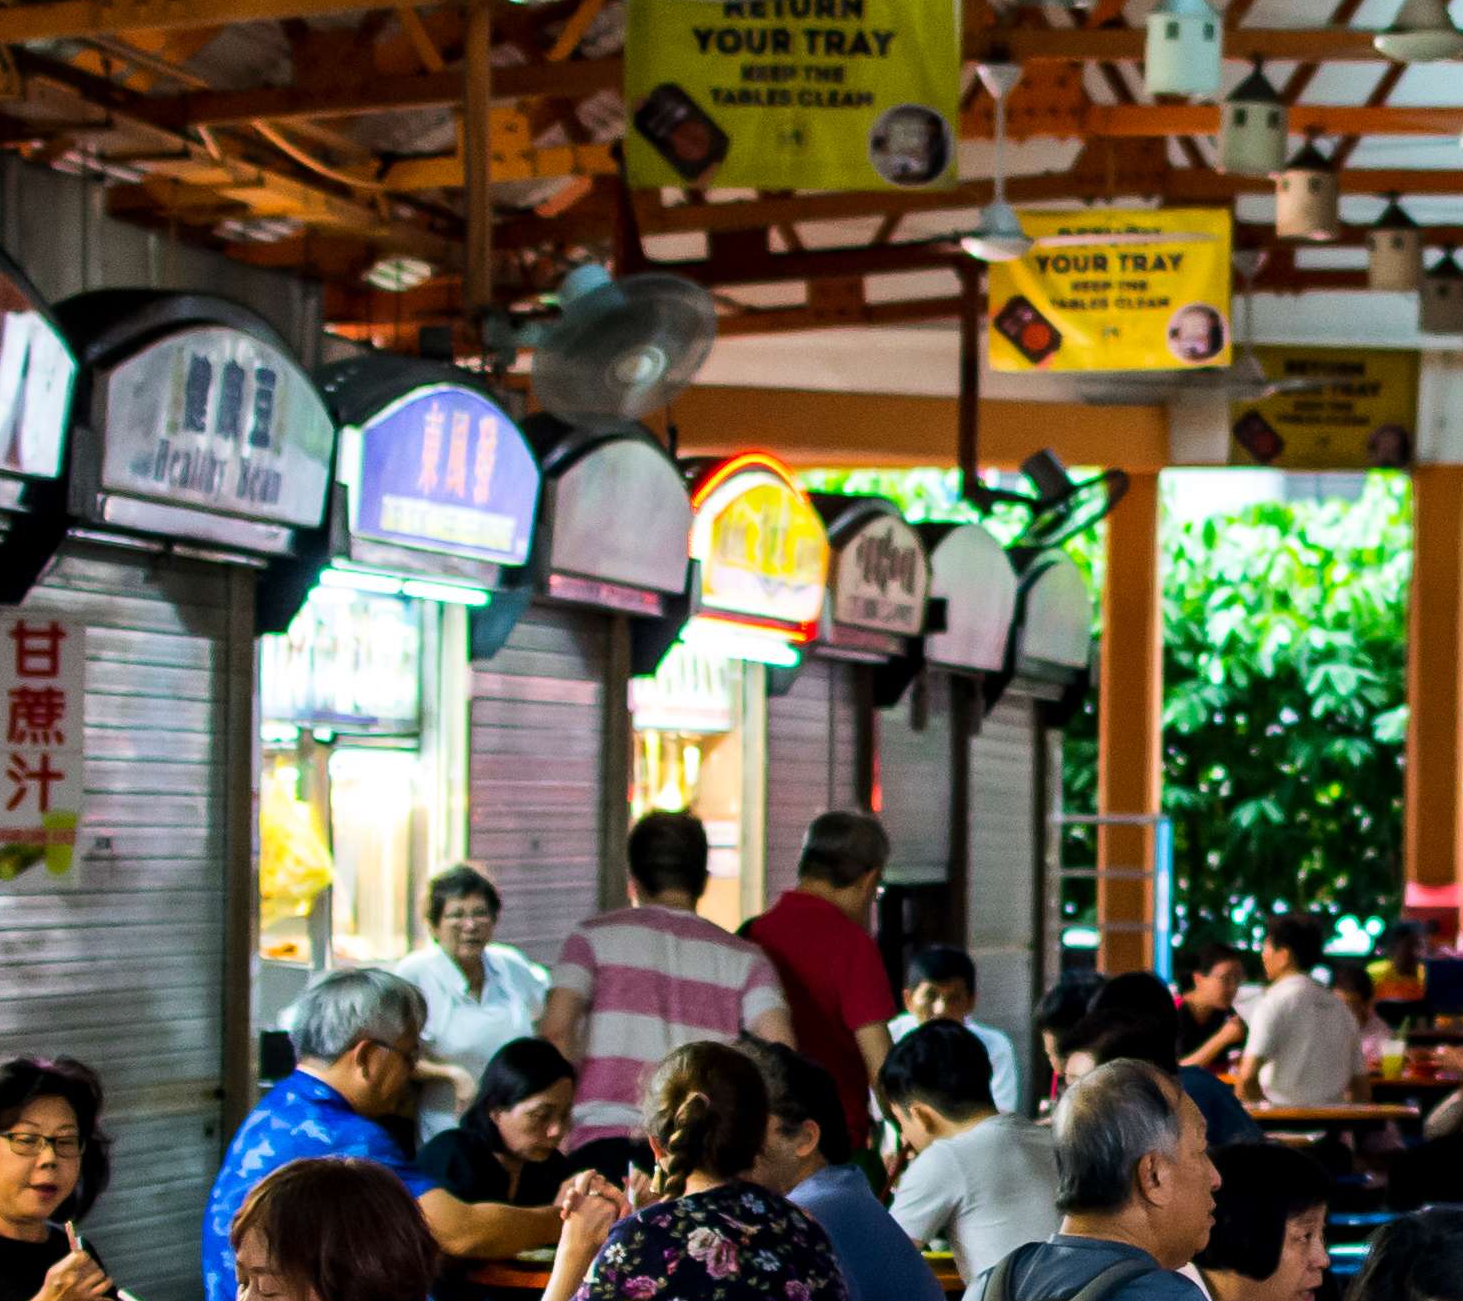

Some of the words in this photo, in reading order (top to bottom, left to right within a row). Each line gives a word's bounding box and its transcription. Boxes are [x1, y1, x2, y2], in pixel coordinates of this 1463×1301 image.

[692, 27, 794, 55] YOUR
[803, 27, 896, 58] TRAY
[804, 64, 846, 84] THE
[1036, 253, 1109, 274] YOUR
[1117, 252, 1185, 273] TRAY
[6, 618, 67, 814] 甘蔗汁
